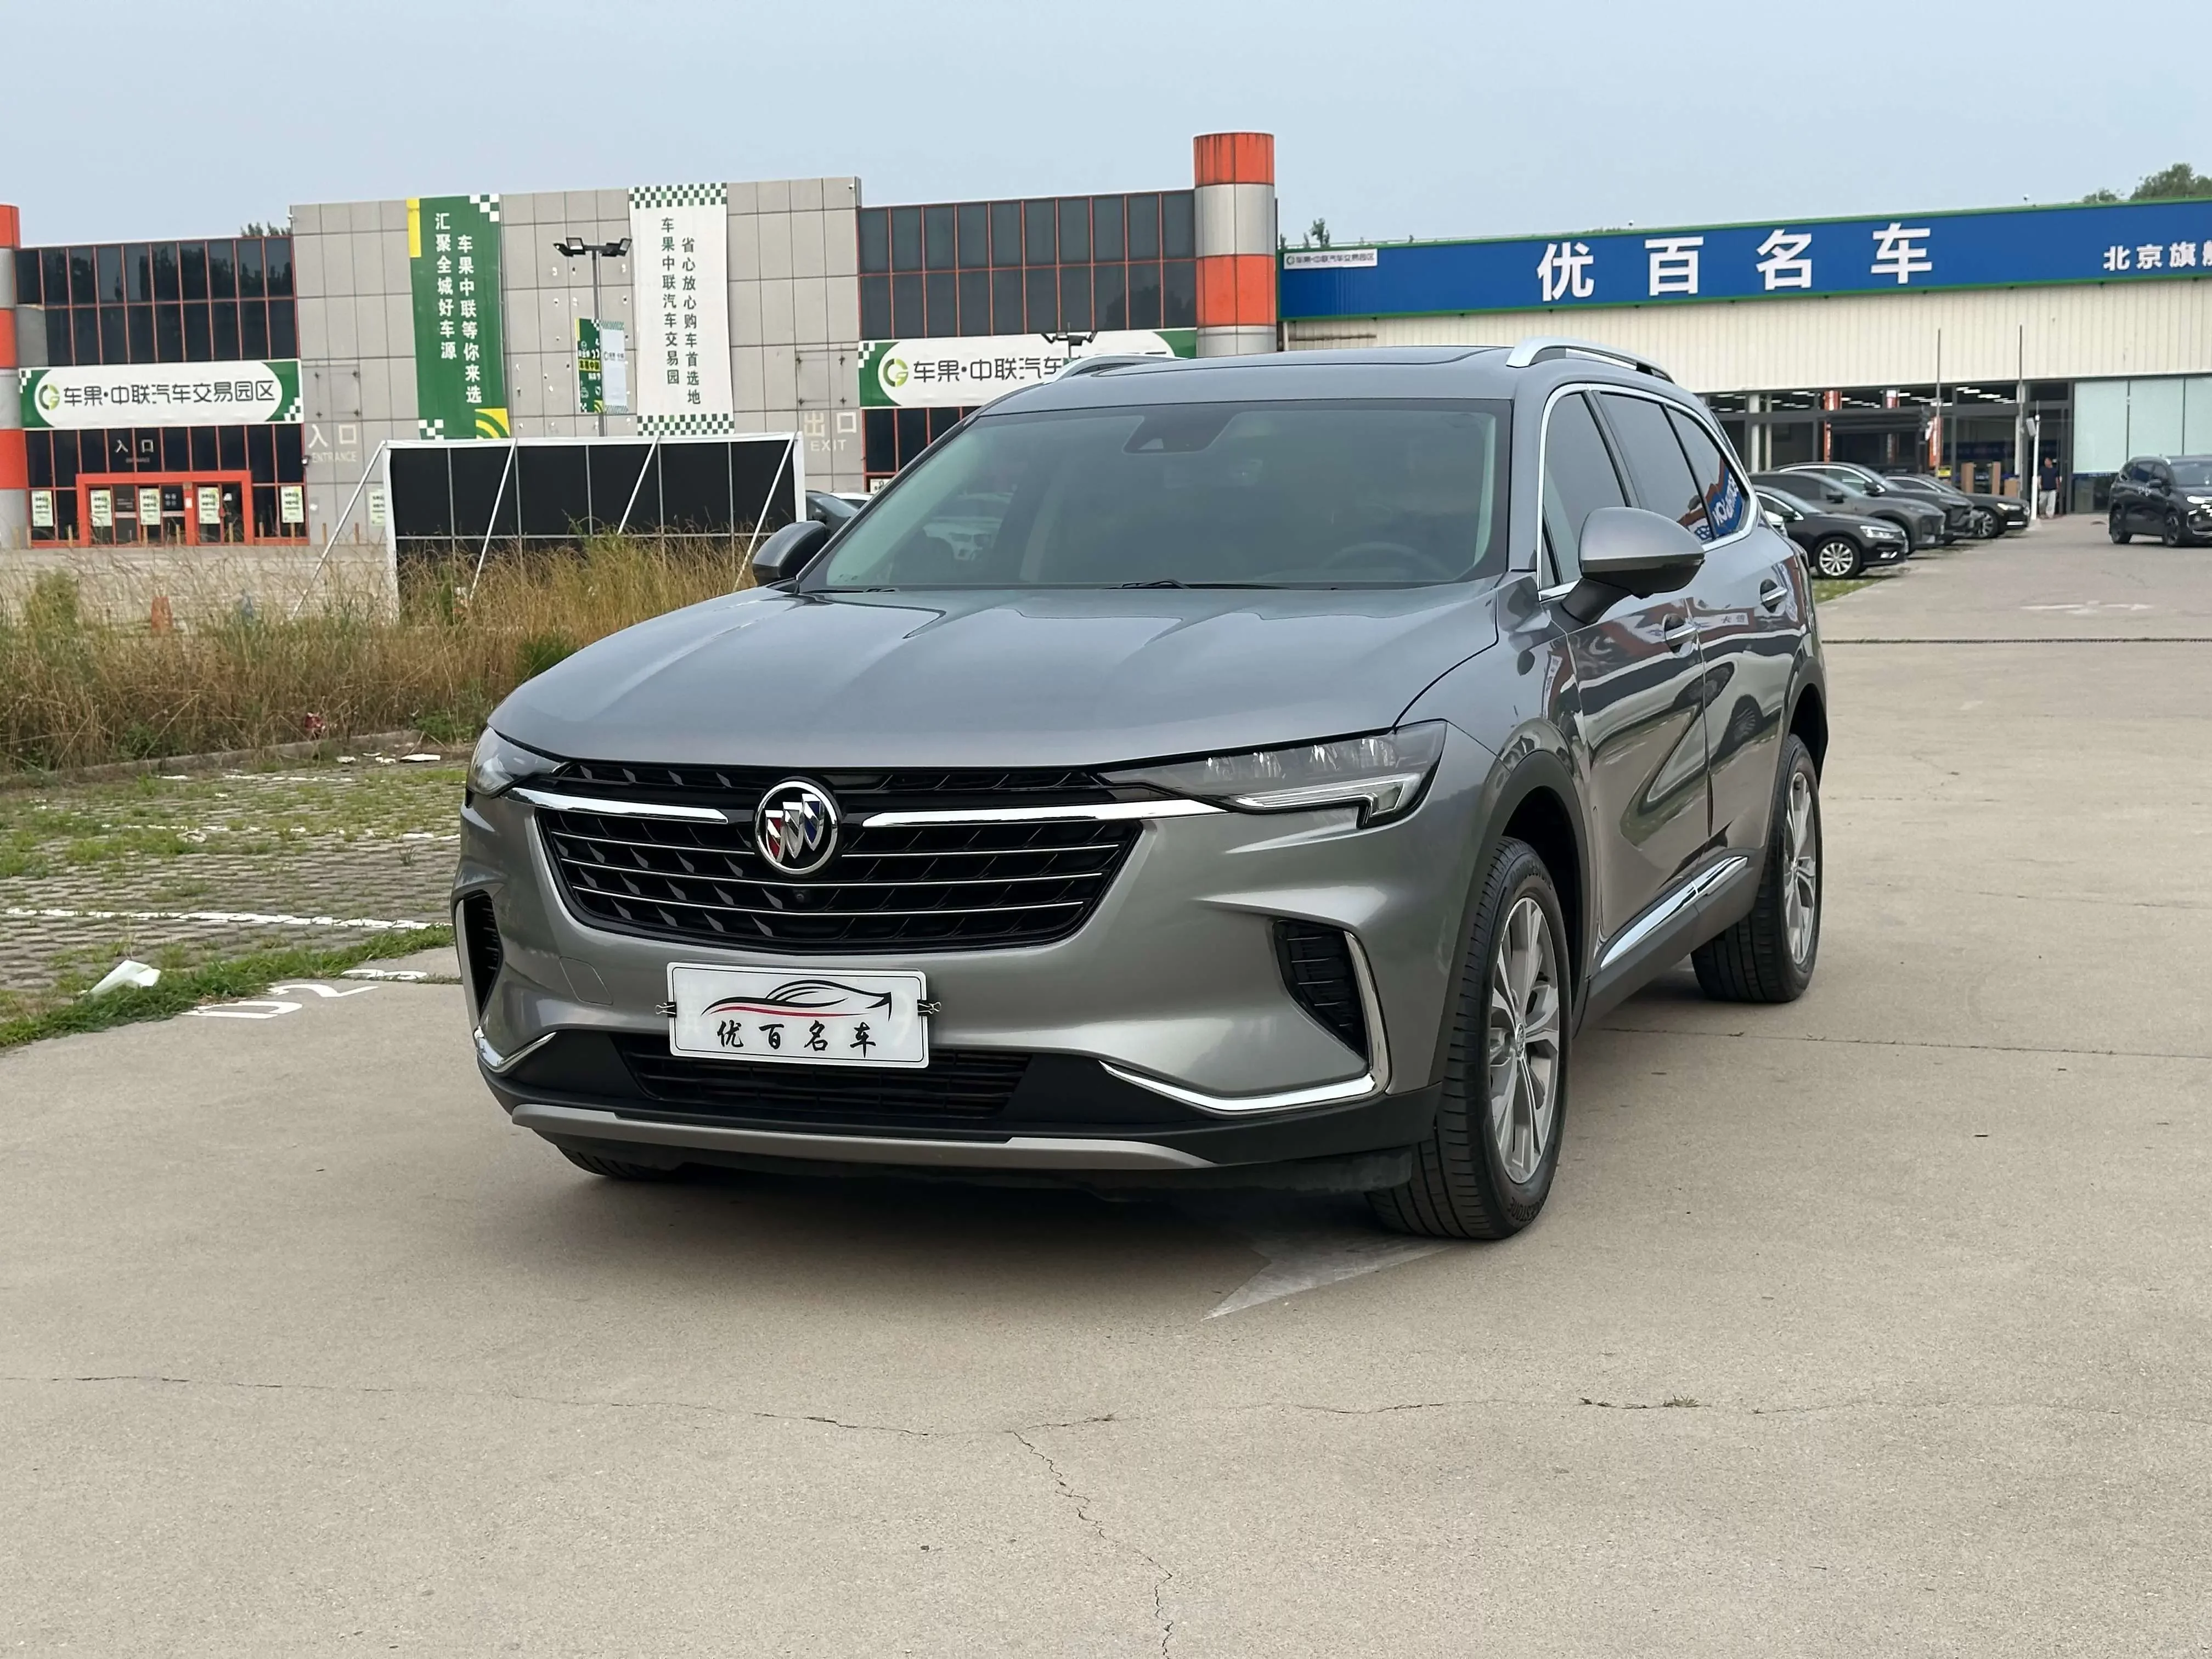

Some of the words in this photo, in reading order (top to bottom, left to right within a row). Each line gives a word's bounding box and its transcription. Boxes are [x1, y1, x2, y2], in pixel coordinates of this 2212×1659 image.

[1537, 222, 1932, 302] 优百名车
[435, 212, 457, 360] 汇聚全城好车源
[661, 217, 680, 385] 车果中联汽车交易园
[458, 234, 482, 404] 车果中联等你来选
[681, 237, 701, 405] 省心放心购车首选地
[913, 352, 1080, 383] 车果·中联汽车
[63, 380, 276, 407] 车果·中联汽车交易园区
[308, 423, 357, 448] 入口
[804, 410, 857, 437] 出口
[115, 439, 154, 453] 入口
[810, 439, 847, 452] EXIT
[716, 1020, 877, 1058] 优百名车
